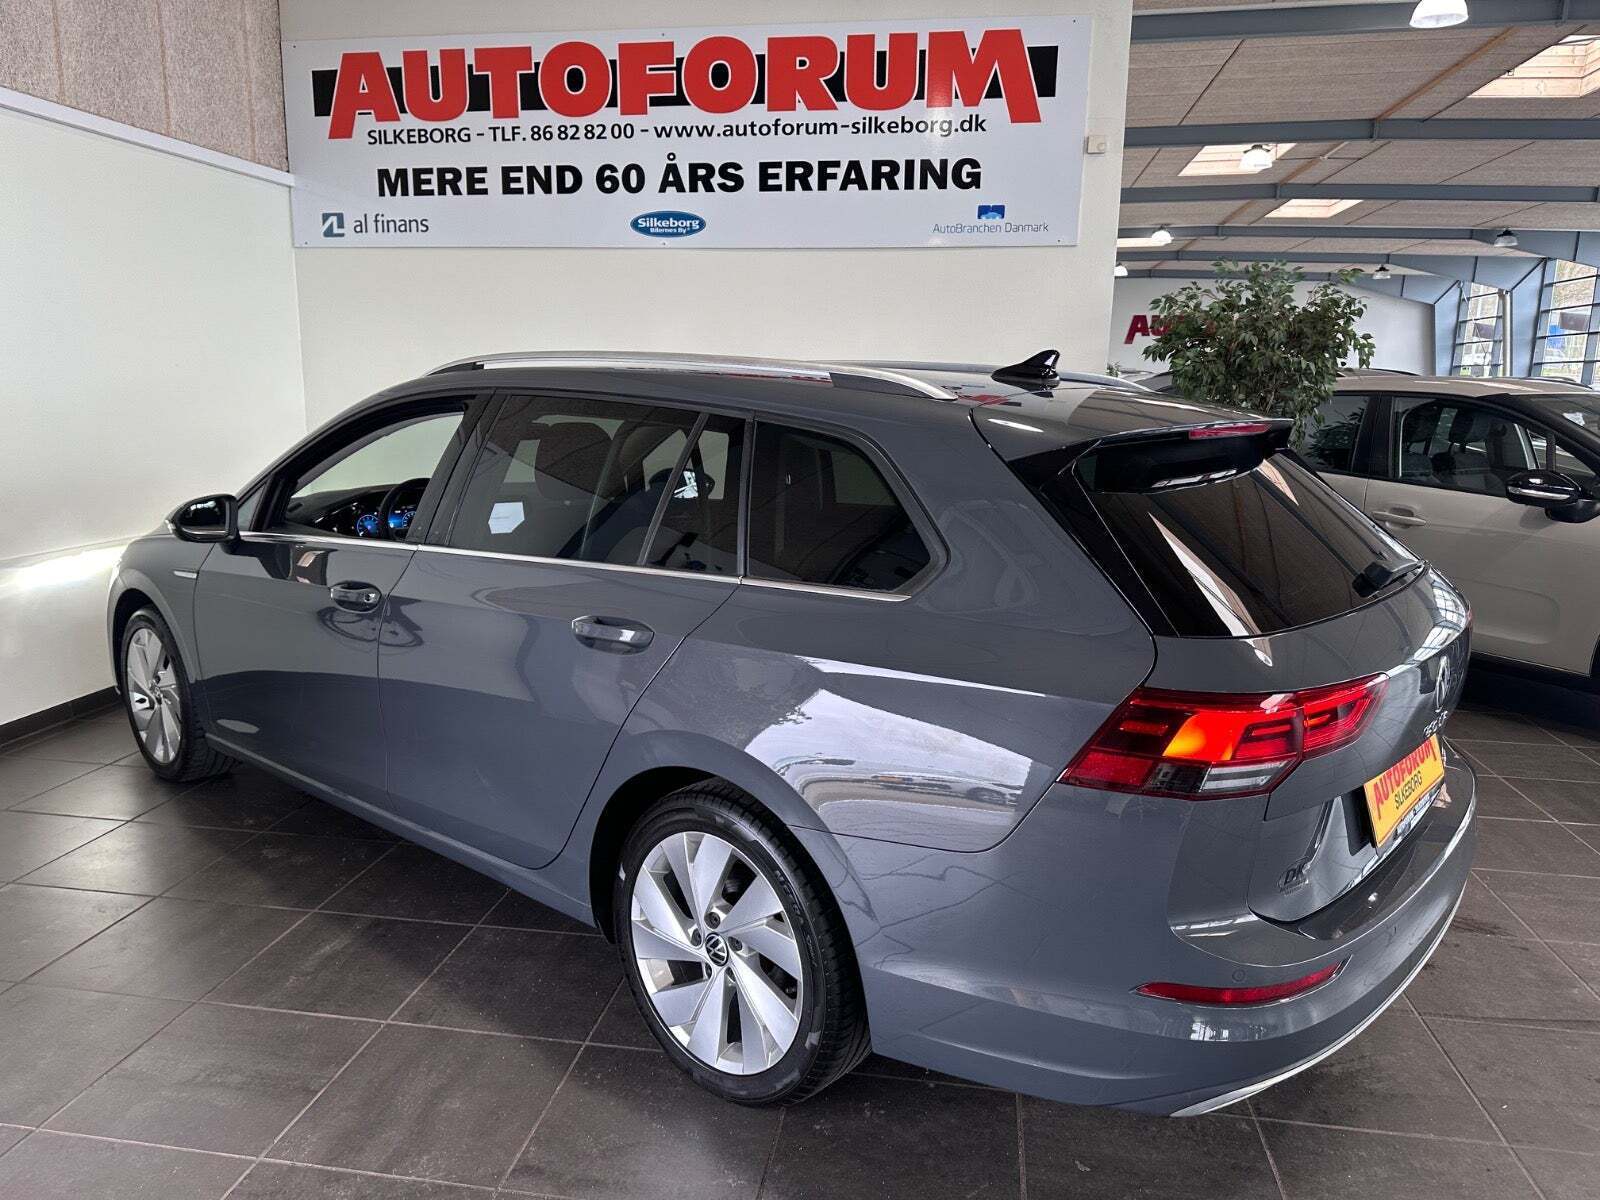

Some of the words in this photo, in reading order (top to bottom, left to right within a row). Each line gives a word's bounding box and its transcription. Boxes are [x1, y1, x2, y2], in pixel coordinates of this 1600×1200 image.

[328, 28, 1042, 139] AUTOFORUM
[367, 127, 471, 145] SILKEBORG
[488, 126, 526, 142] TLF.
[653, 115, 987, 138] www.autoforum-silkeborg.dk
[377, 166, 489, 197] MERE
[501, 164, 583, 195] END
[595, 163, 645, 194] 60
[658, 152, 744, 193] ÅRS
[758, 157, 982, 192] ERFARING
[353, 213, 368, 234] al
[373, 213, 429, 233] finans
[637, 217, 700, 230] Silkeborg
[932, 221, 1002, 234] AutoBranchen
[1004, 220, 1049, 233] Danmark
[1373, 739, 1437, 821] AUTOFORUM
[1394, 770, 1423, 810] SILKEBORG
